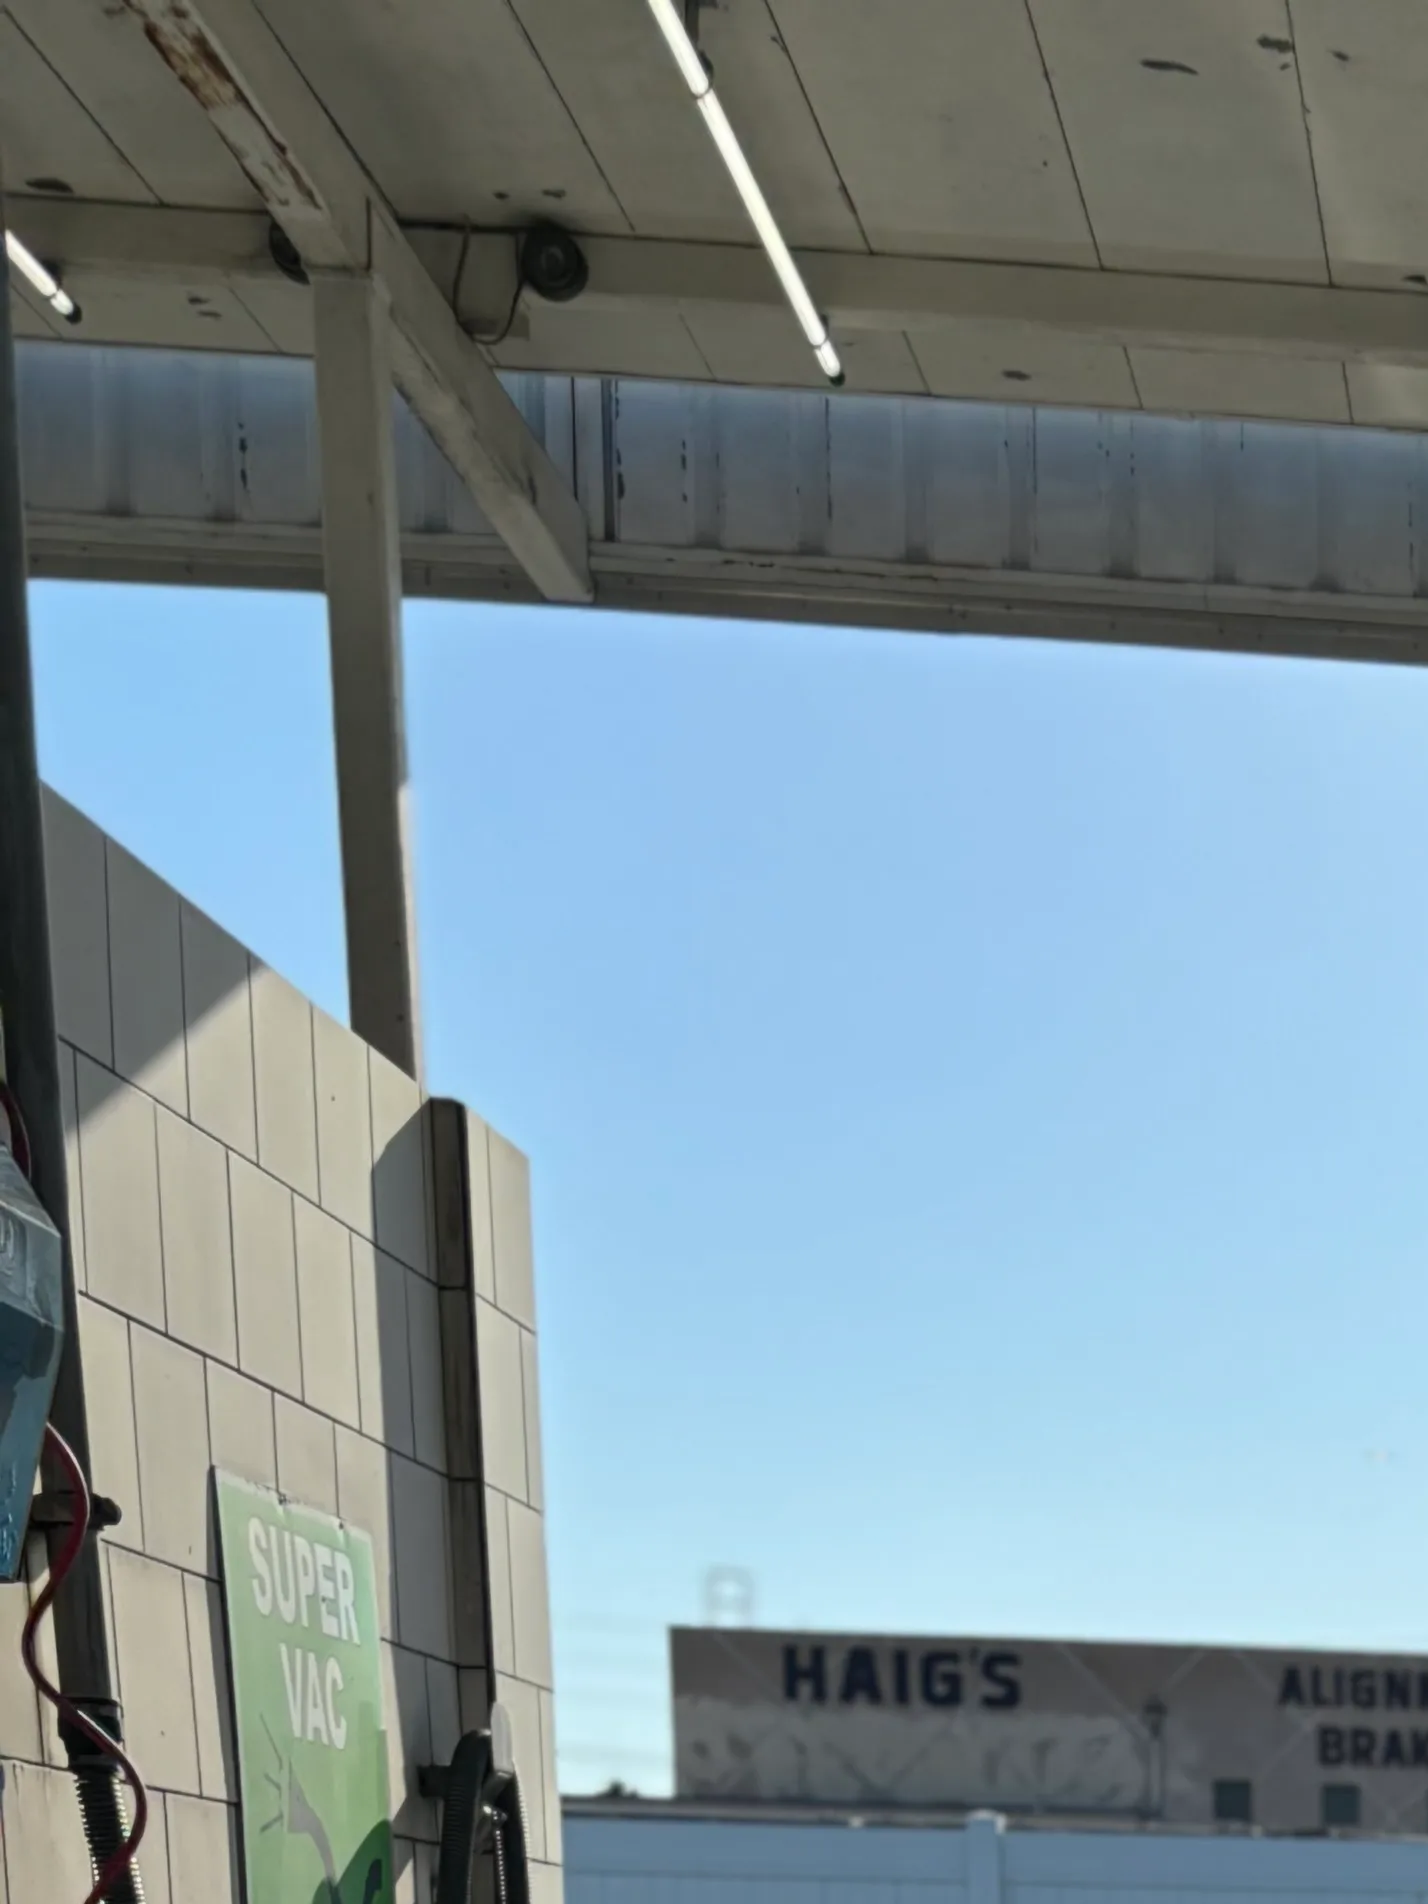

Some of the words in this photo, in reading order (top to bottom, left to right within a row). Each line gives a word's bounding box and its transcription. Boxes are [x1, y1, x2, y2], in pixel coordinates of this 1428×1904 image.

[249, 1516, 361, 1646] SUPER
[279, 1642, 347, 1750] VAC
[782, 1645, 1023, 1709] HAIG'S
